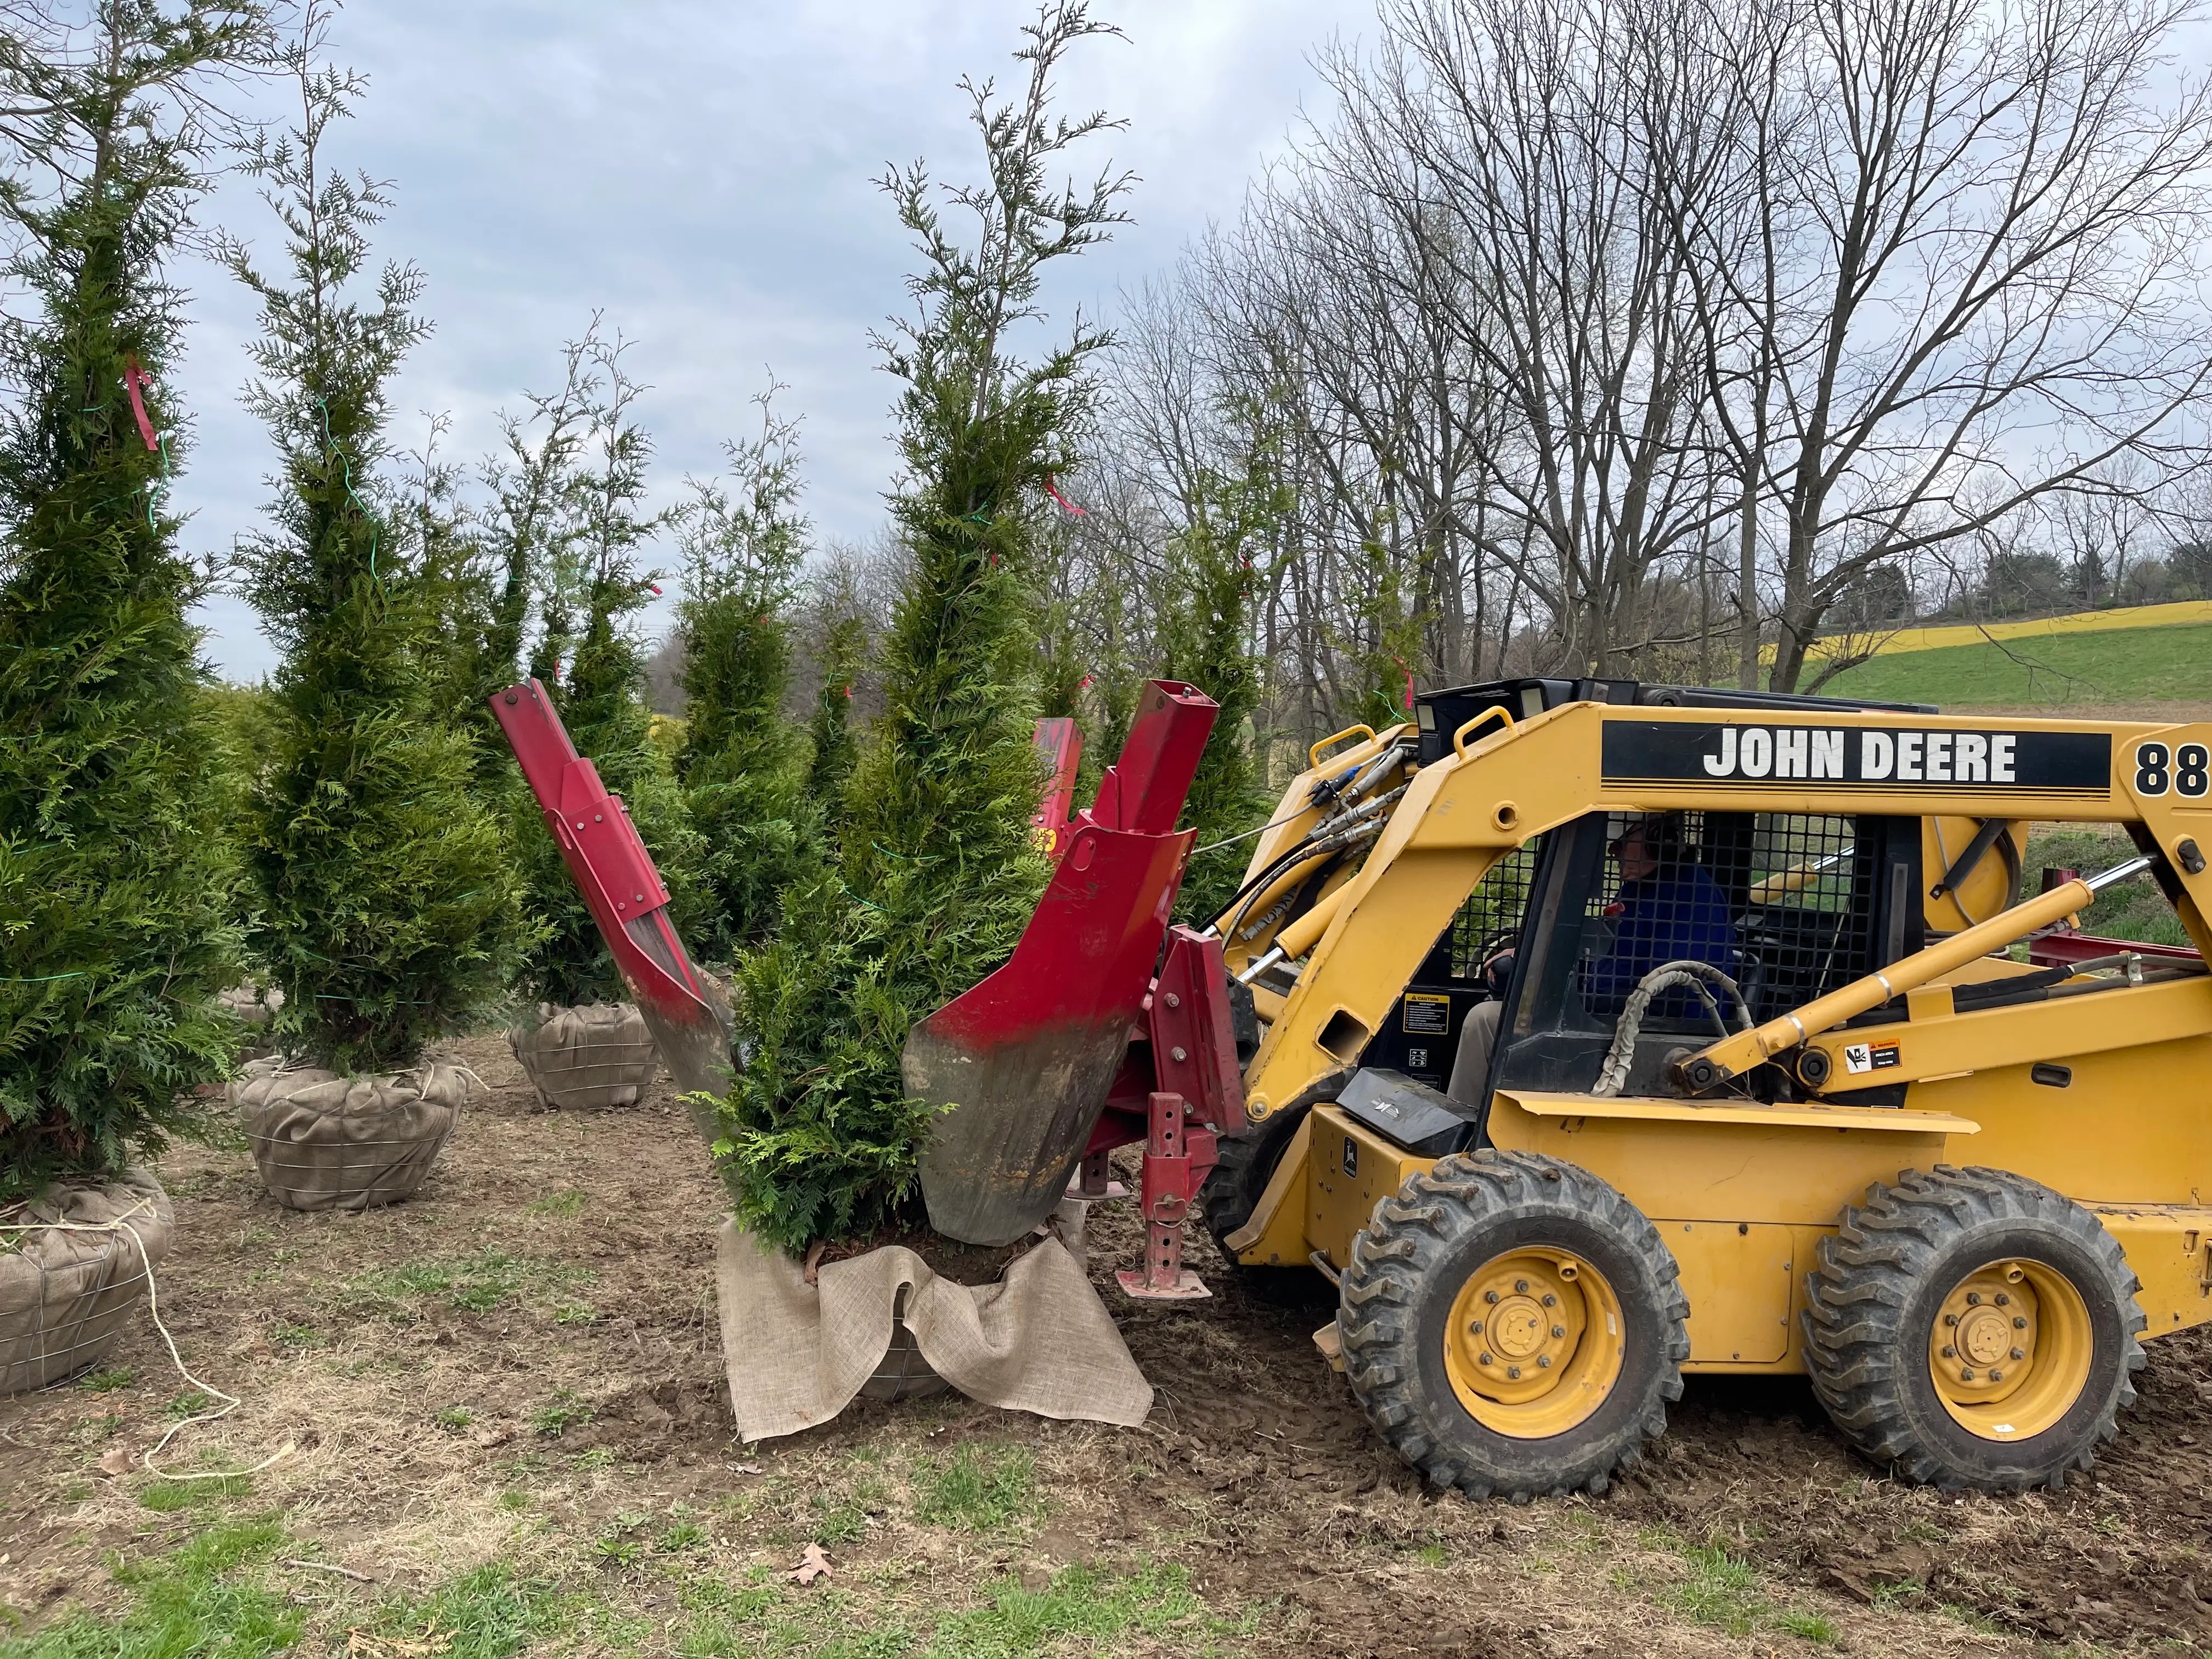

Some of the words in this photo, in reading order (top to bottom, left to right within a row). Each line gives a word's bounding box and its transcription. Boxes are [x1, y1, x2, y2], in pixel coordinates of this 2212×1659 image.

[1703, 727, 1845, 779] JOHN
[1860, 731, 2017, 783] DEERE
[2134, 741, 2211, 799] 88
